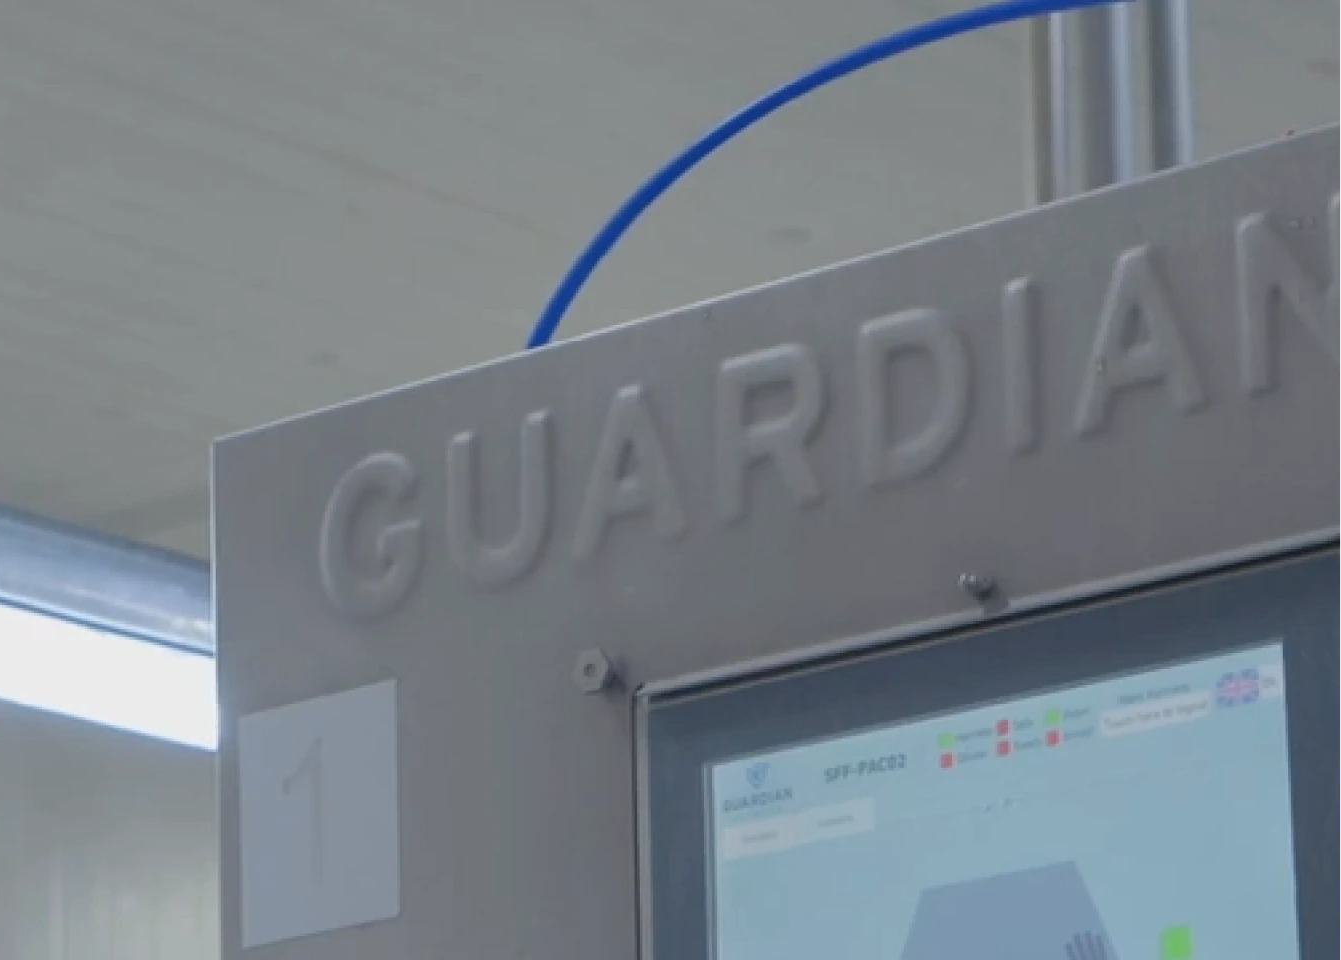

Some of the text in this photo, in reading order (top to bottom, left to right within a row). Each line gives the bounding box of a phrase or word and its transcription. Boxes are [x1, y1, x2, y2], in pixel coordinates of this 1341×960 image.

[318, 188, 1341, 621] GUARDIAN
[281, 736, 324, 888] 1
[723, 787, 793, 813] GUARDIAN
